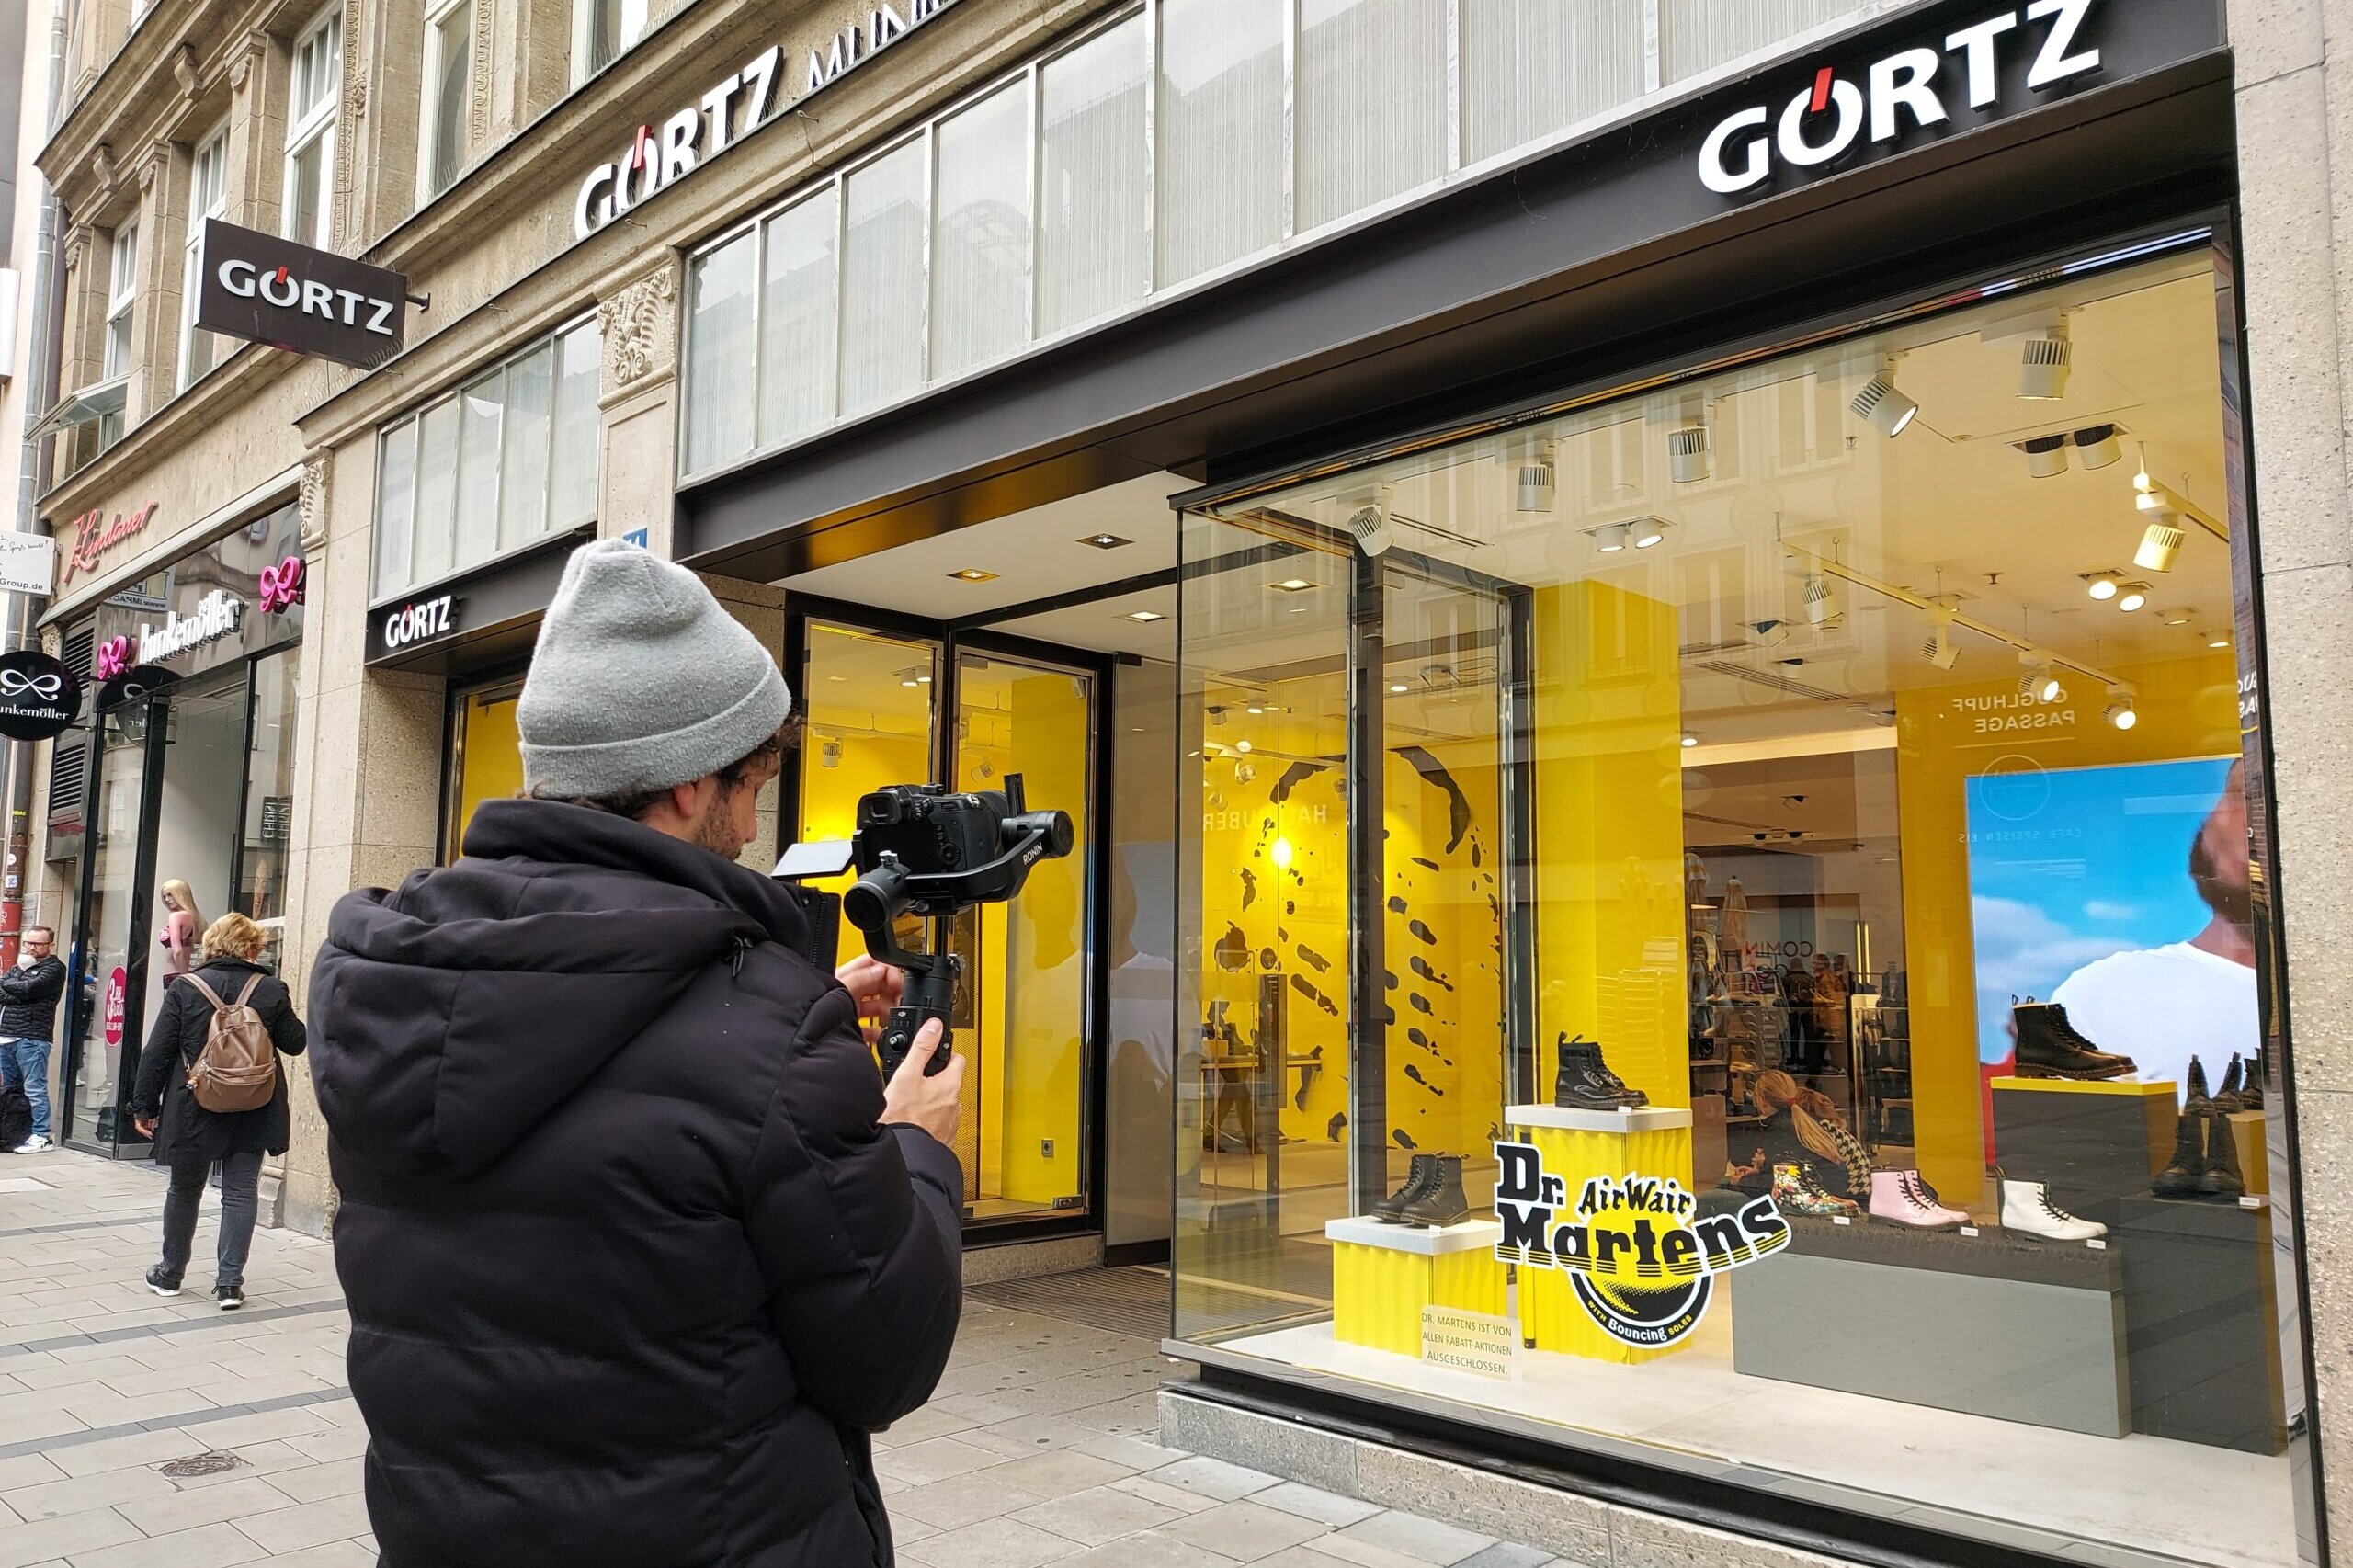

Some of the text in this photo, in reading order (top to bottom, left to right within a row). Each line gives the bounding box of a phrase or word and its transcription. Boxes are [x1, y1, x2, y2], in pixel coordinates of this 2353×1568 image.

[1022, 841, 1043, 866] RONIN
[1495, 1142, 1564, 1207] Dr.
[1577, 1177, 1693, 1216] AirWair
[1495, 1198, 1790, 1278] Martens
[1421, 1312, 1512, 1337] DR. MARTENS IST VON
[1587, 1299, 1693, 1343] WITH Bouncing SOLES
[1422, 1331, 1512, 1357] ALLEN RABATT-AKTIONEN
[1427, 1350, 1508, 1376] AUSGESCHLOSSEN.
